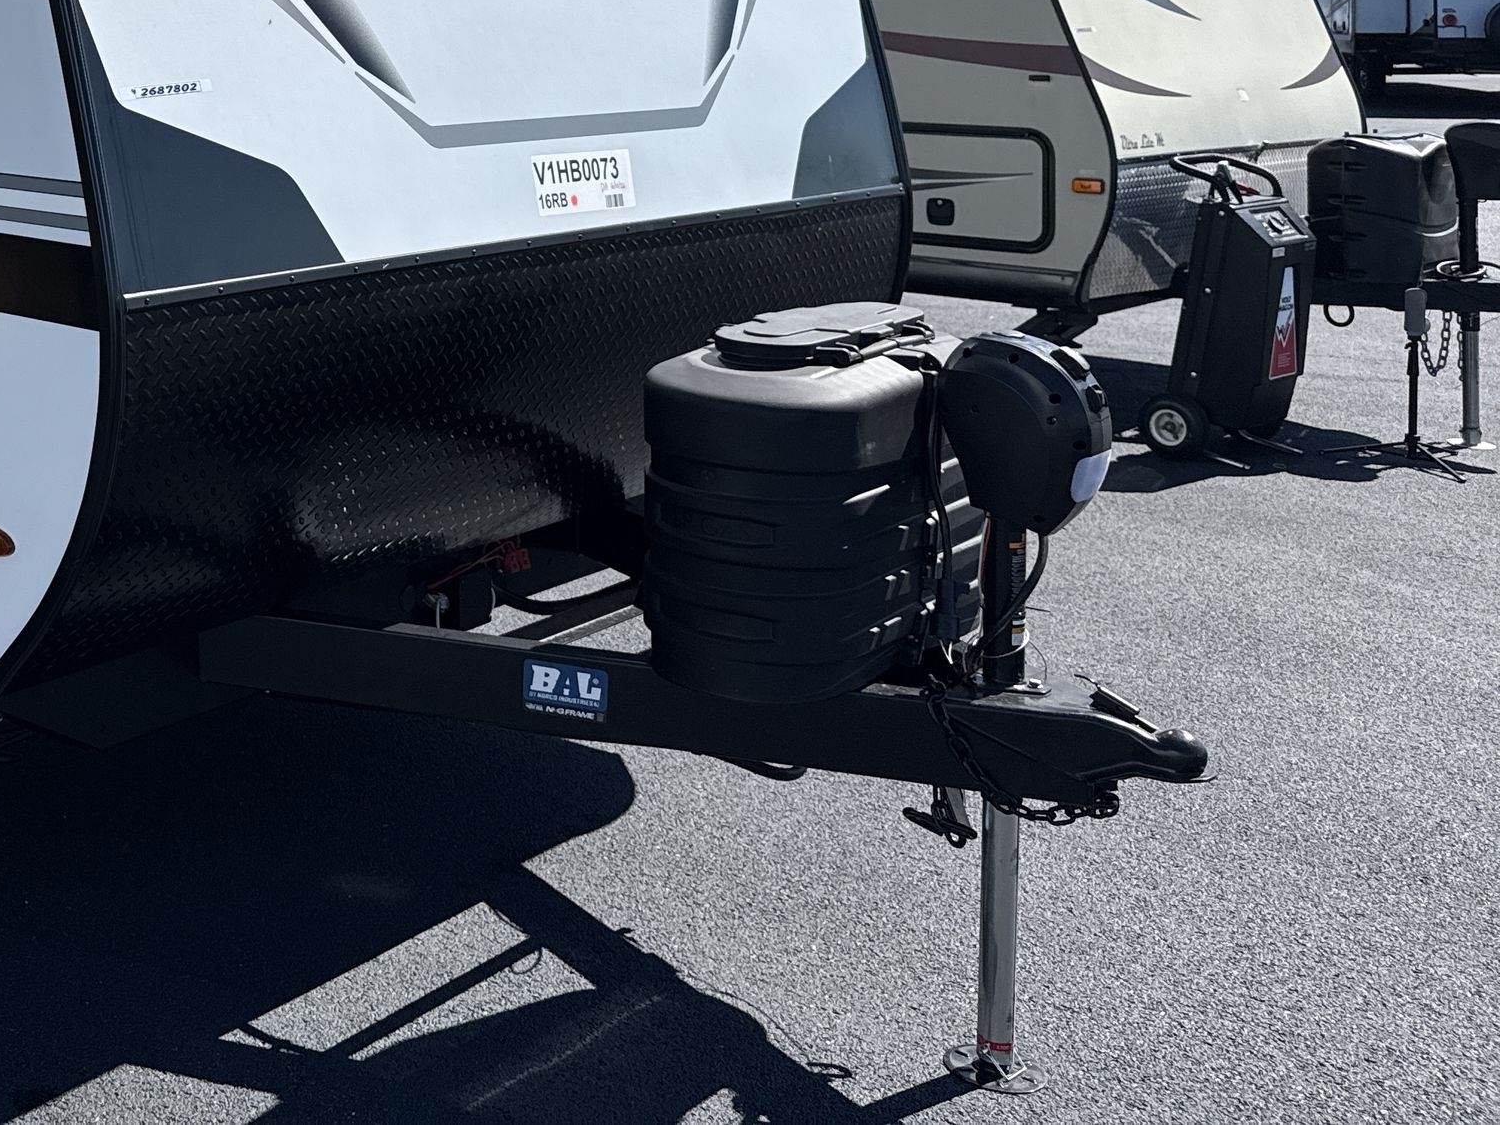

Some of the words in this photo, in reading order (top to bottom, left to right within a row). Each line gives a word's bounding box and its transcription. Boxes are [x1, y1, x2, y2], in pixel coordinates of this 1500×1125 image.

[141, 82, 197, 97] 2687802
[533, 156, 619, 185] V1HB0073
[539, 192, 568, 209] 16RB
[530, 664, 601, 700] BAL
[565, 708, 595, 720] FRAME
